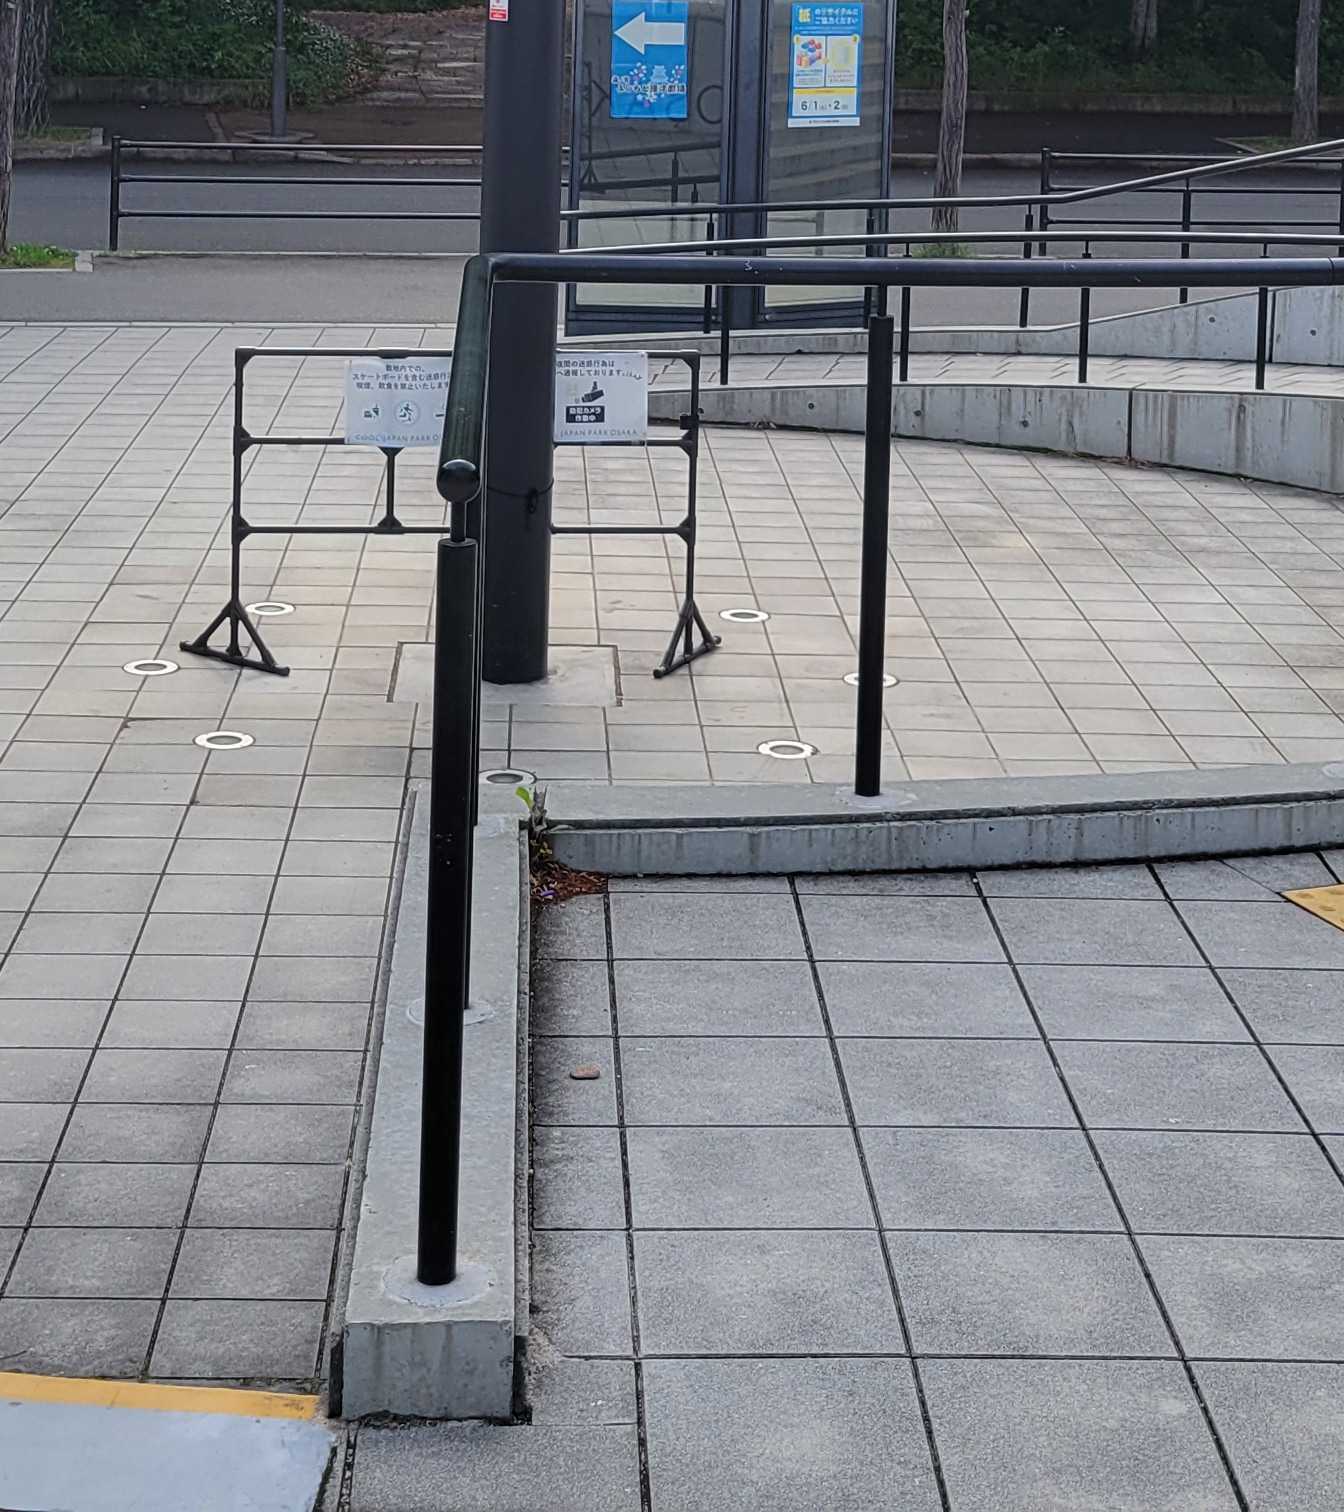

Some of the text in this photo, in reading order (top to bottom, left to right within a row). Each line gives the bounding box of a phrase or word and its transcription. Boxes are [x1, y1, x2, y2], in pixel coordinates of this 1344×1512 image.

[385, 364, 426, 373] 敷地内での、
[560, 429, 586, 437] JAPAN
[355, 434, 380, 442] COOL
[382, 434, 408, 442] JAPAN
